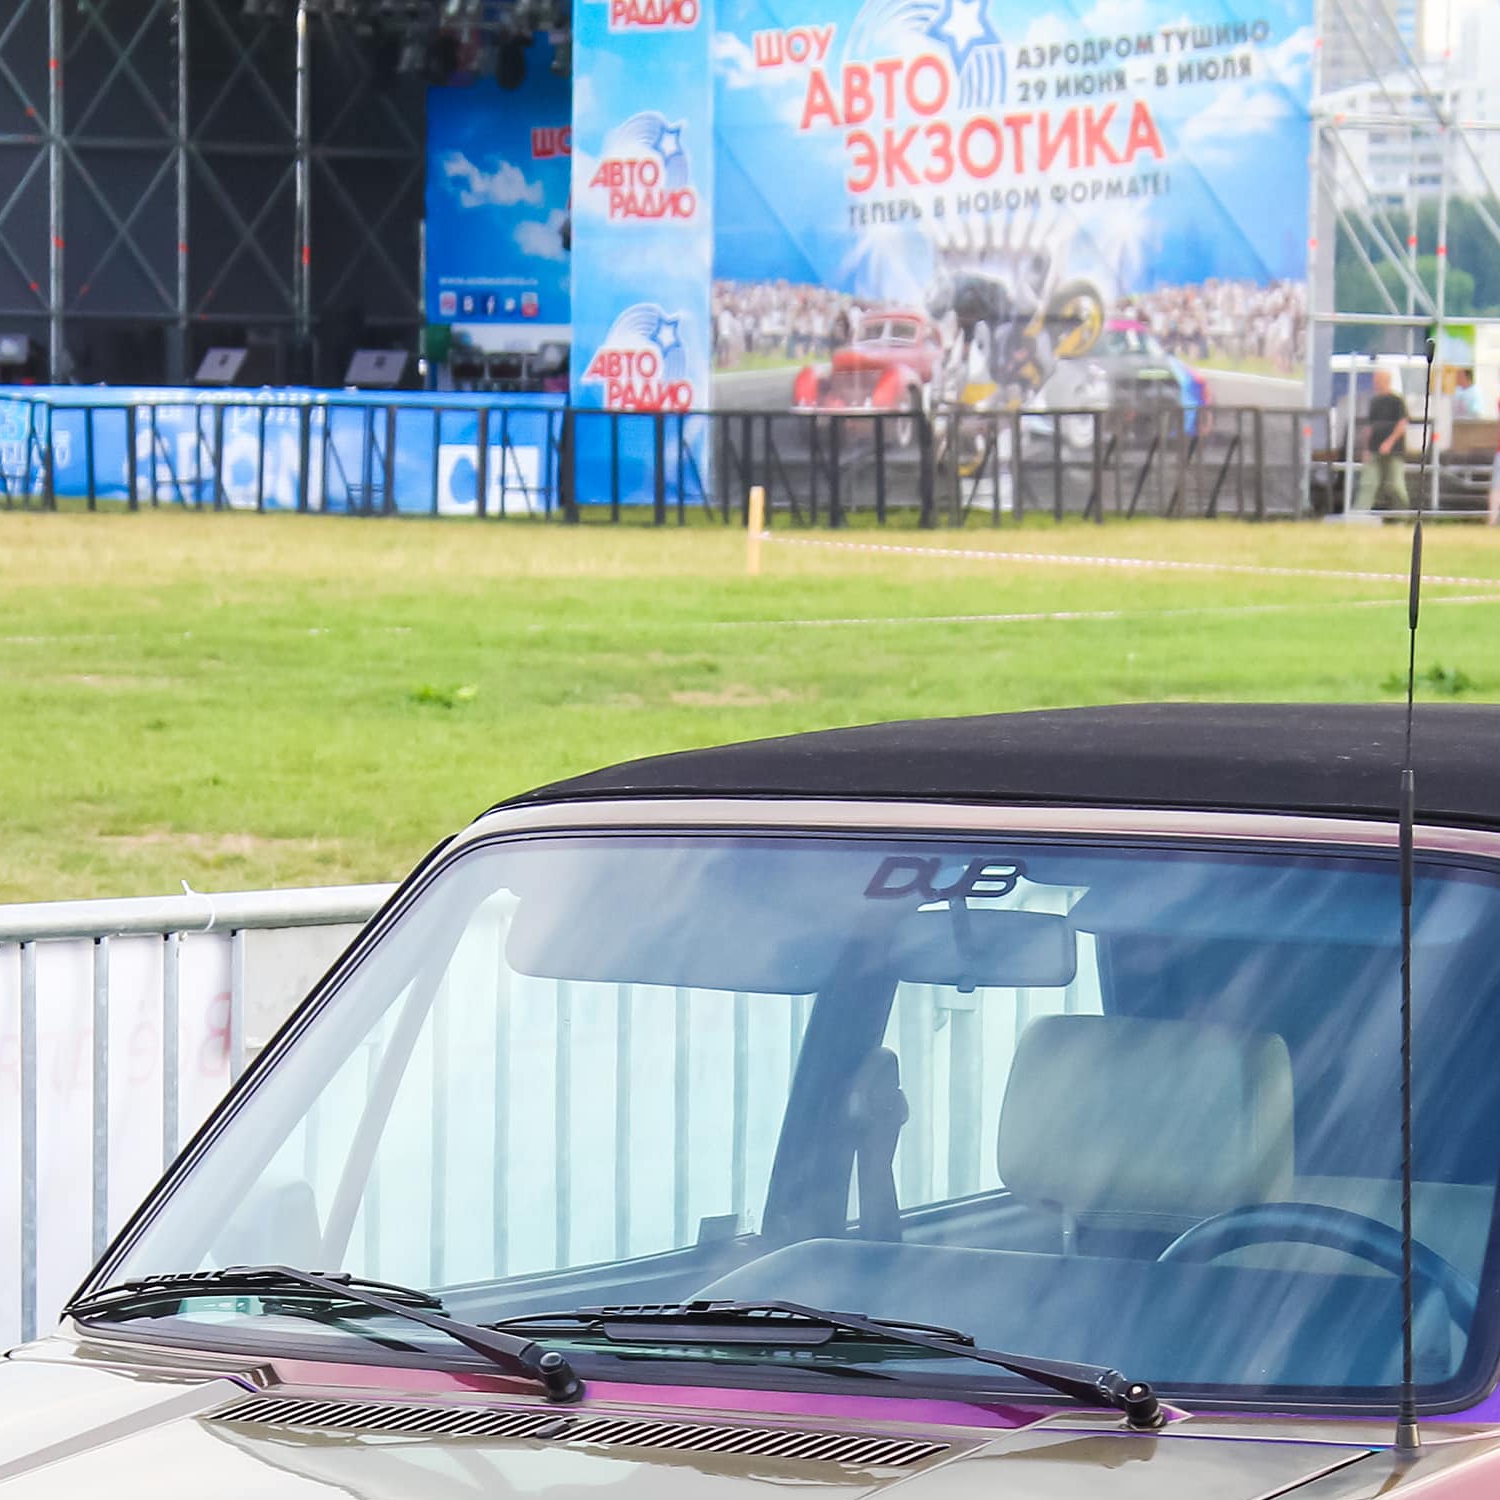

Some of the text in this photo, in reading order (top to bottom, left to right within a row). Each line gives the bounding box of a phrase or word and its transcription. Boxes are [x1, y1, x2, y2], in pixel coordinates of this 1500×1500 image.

[755, 25, 836, 68] ШОУ
[1016, 20, 1271, 70] АЭРОДРОМ ТУШИНО
[801, 54, 950, 130] АВТО
[1018, 76, 1048, 102] 29
[1055, 67, 1126, 99] ИЮНЯ
[1154, 61, 1170, 87] 8
[1177, 54, 1253, 85] ИЮЛЯ
[847, 101, 1167, 194] ЭКЗОТИКА
[590, 157, 660, 189] АВТО
[609, 189, 696, 219] РАДИО
[848, 201, 924, 228] ТЕПЕРЬ
[933, 197, 947, 219] В
[956, 189, 1042, 216] НОВОМ
[583, 349, 658, 381] АВТО
[607, 382, 694, 412] РАДИО
[863, 856, 1027, 900] DUB
